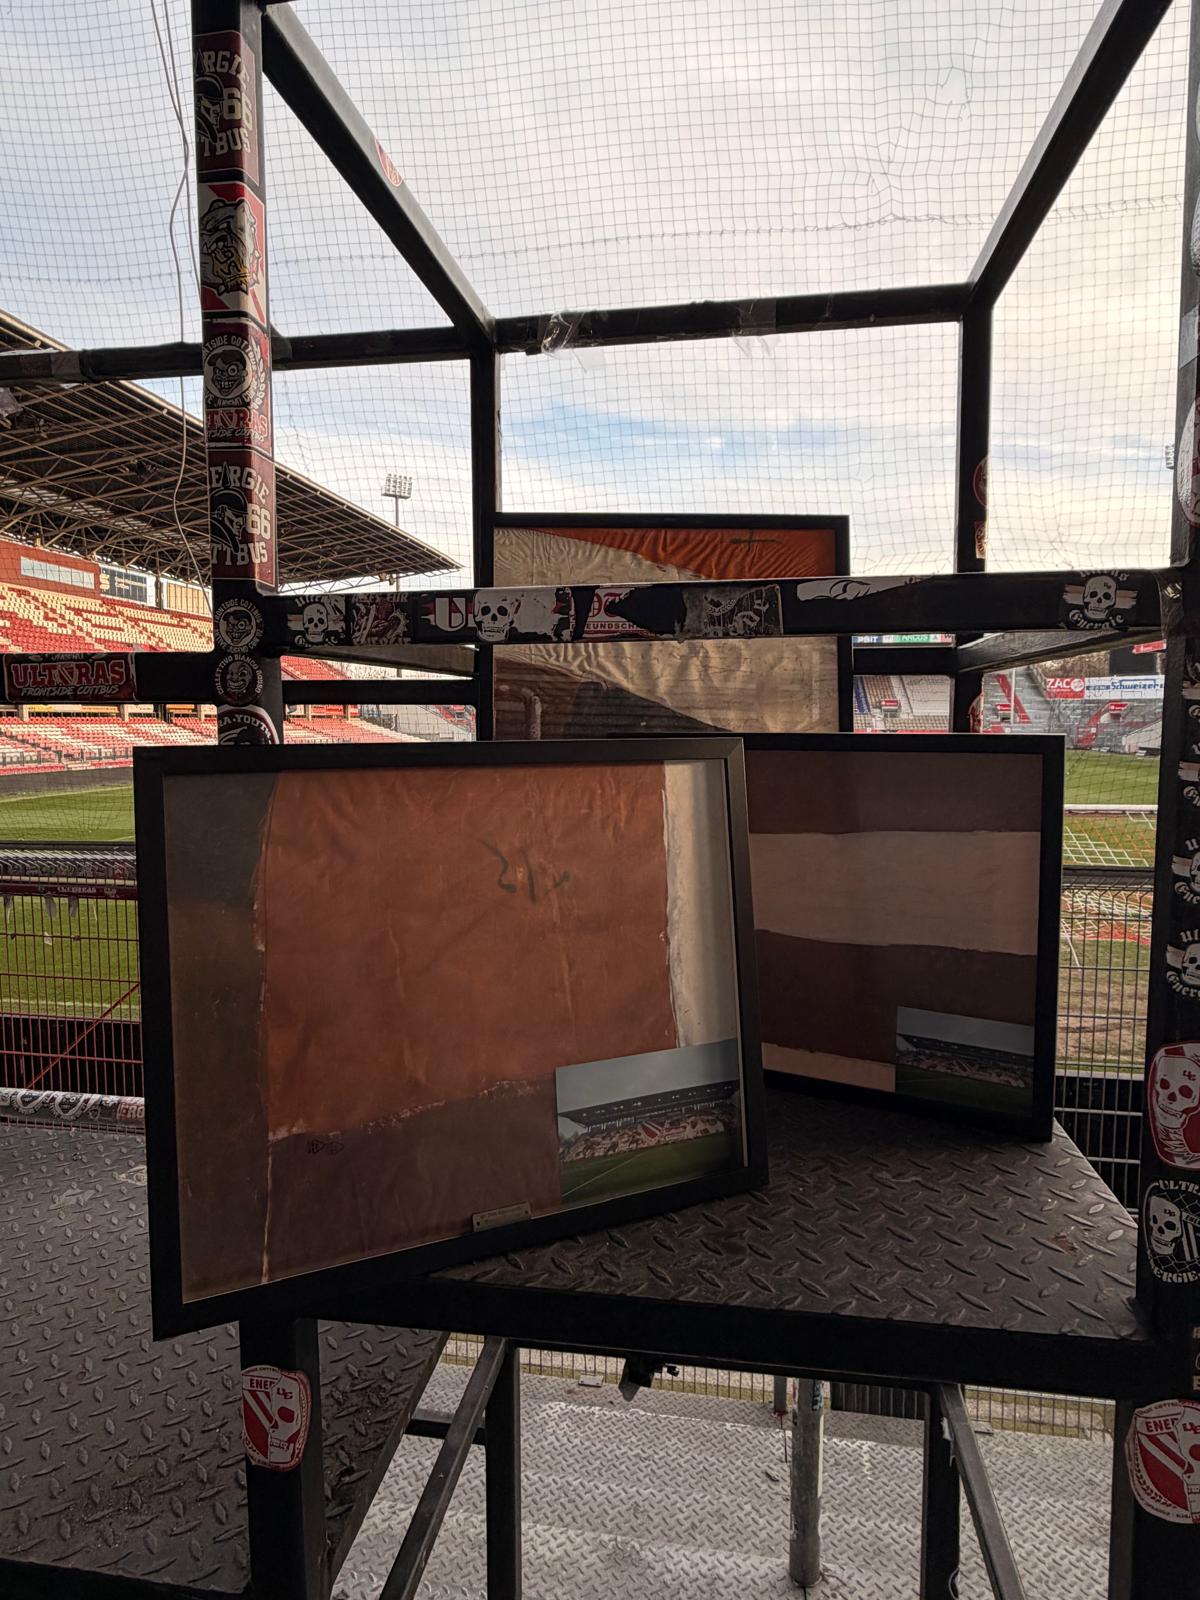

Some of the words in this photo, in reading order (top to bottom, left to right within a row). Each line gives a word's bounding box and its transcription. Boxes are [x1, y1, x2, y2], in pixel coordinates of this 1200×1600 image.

[223, 87, 252, 131] 66
[246, 503, 271, 540] 66
[21, 686, 76, 697] FRONTSIDE
[77, 684, 120, 695] COTTBUS
